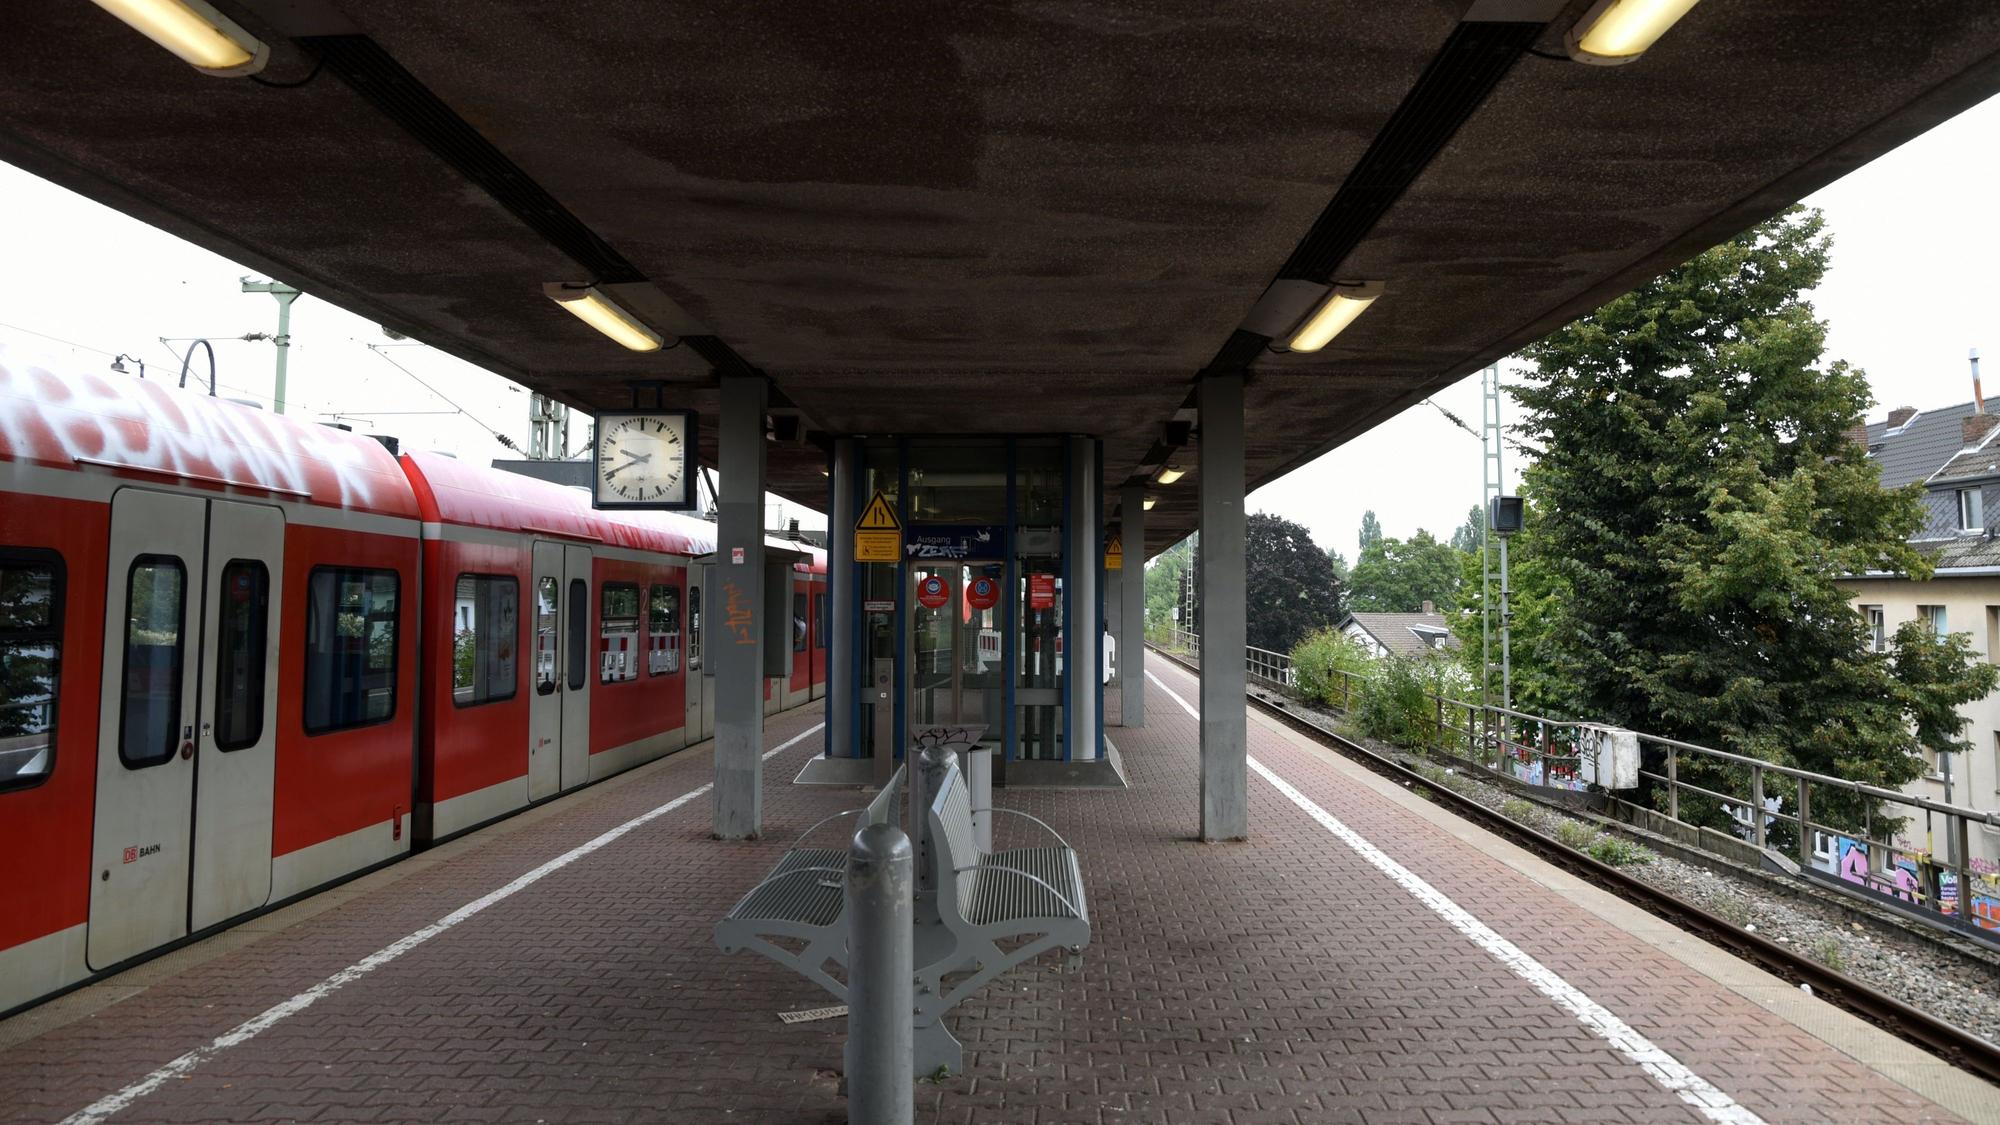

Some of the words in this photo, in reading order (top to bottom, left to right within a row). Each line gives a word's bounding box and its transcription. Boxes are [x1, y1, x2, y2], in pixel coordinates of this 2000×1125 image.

[917, 535, 951, 545] Ausgang
[641, 588, 648, 614] 2
[124, 848, 137, 862] DB
[139, 844, 160, 857] BAHN
